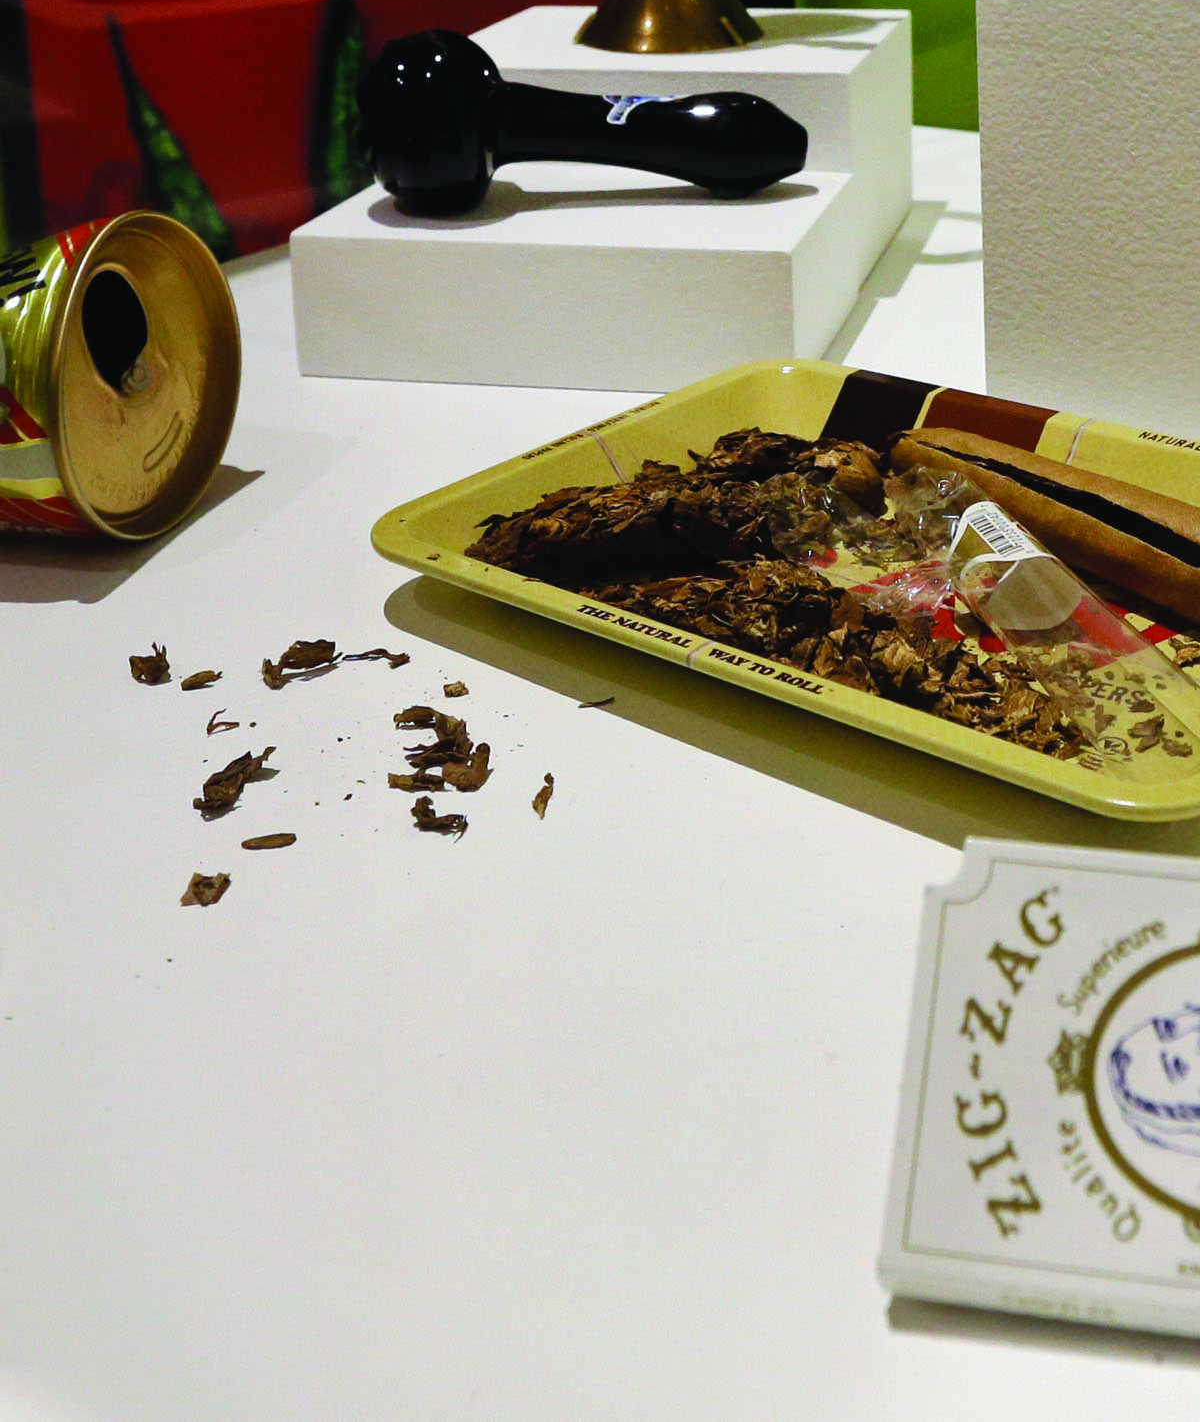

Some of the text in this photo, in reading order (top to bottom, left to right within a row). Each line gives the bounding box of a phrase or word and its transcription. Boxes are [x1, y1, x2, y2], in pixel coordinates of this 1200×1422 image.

[576, 605, 692, 648] THE NATURAL
[708, 648, 825, 695] WAY TO ROLL
[955, 890, 1064, 1238] ZIG-ZAG
